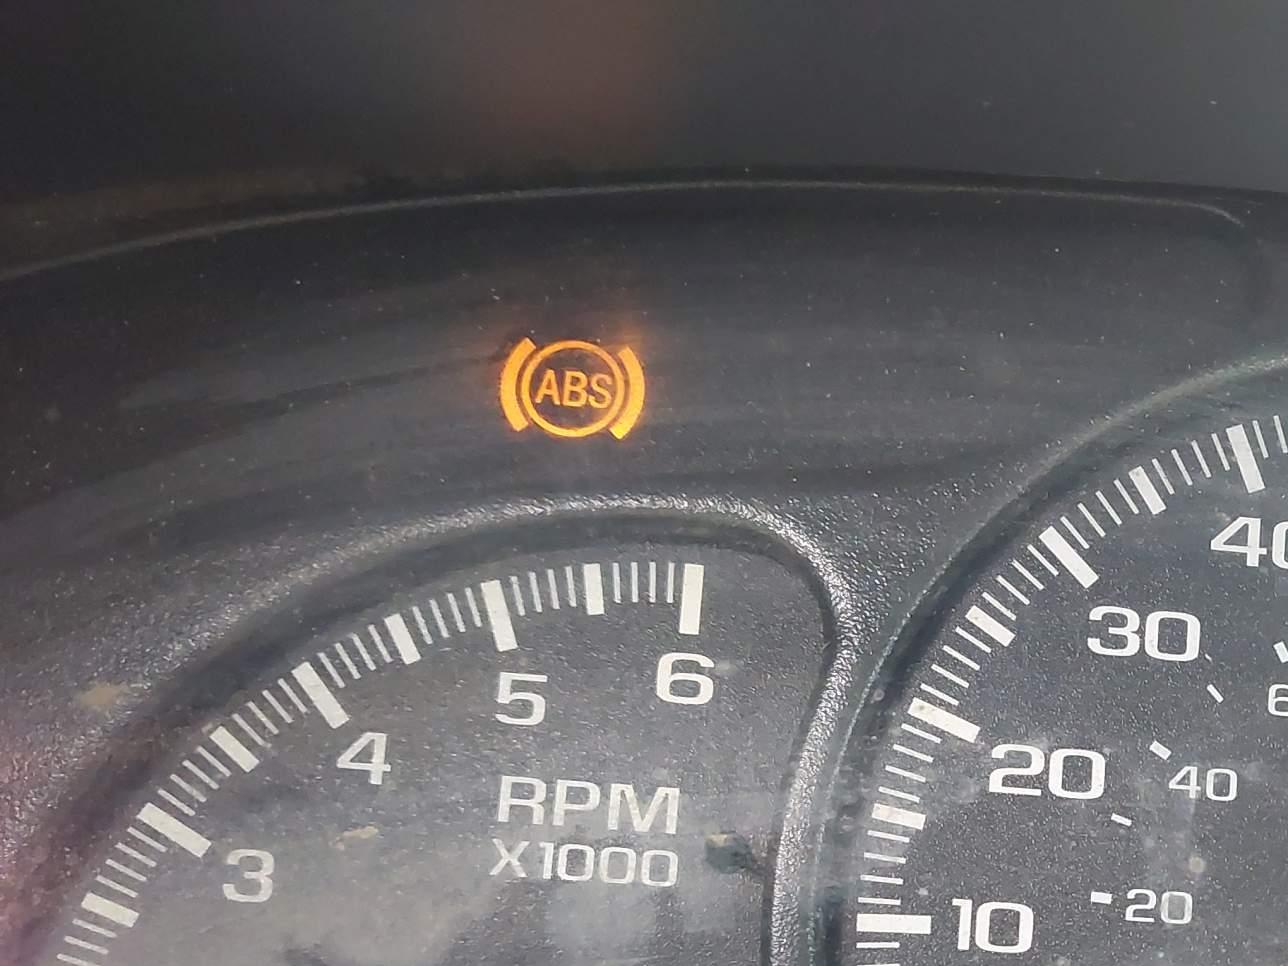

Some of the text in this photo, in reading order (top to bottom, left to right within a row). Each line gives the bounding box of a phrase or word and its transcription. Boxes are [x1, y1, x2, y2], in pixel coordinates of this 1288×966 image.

[535, 369, 613, 409] ABS
[1087, 605, 1201, 662] 30
[495, 672, 549, 727] 5
[655, 652, 715, 706] 6
[336, 732, 392, 786] 4
[988, 744, 1105, 801] 20
[1168, 766, 1238, 802] 40
[498, 775, 680, 836] RPM
[222, 848, 274, 903] 3
[489, 837, 680, 889] X1000
[952, 898, 1034, 955] 10
[1125, 888, 1194, 925] 20
